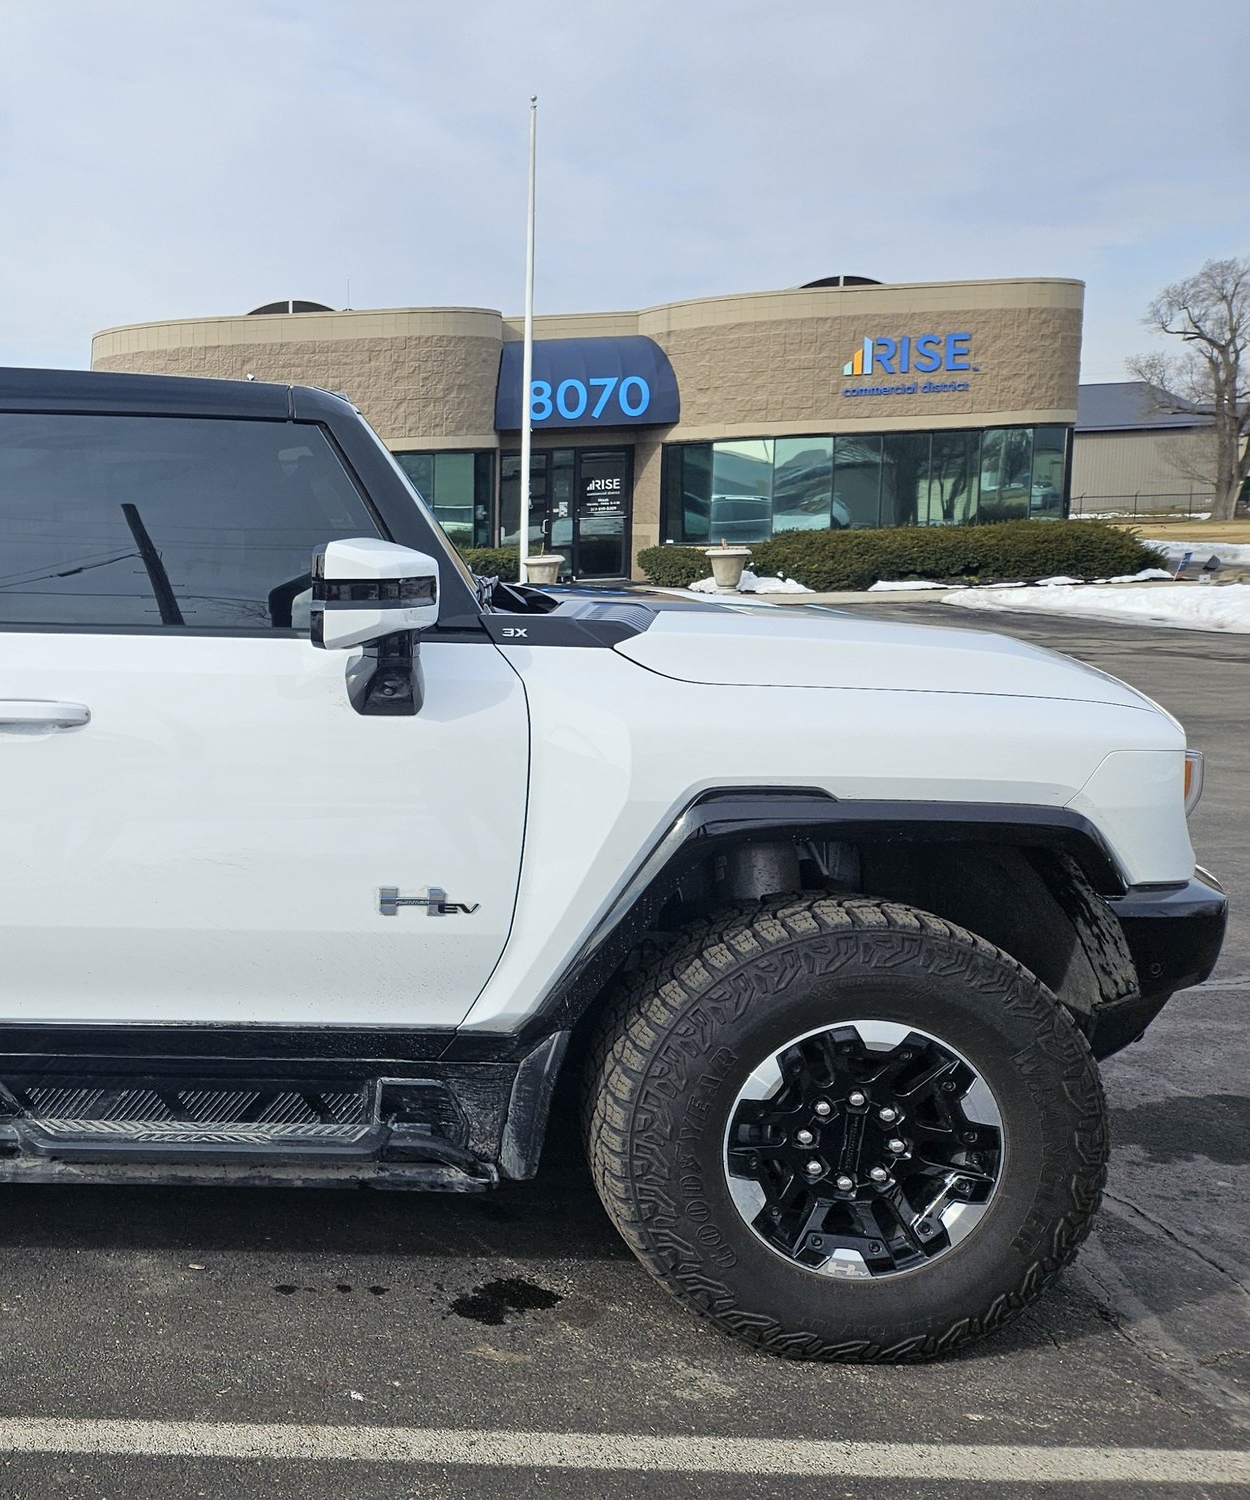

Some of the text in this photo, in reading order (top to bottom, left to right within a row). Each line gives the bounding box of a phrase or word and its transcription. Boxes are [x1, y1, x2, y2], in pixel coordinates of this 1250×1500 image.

[863, 332, 972, 375] RISE
[843, 381, 969, 397] commercial district
[530, 376, 650, 421] 8070
[592, 478, 621, 490] RISE
[502, 627, 528, 638] 3X
